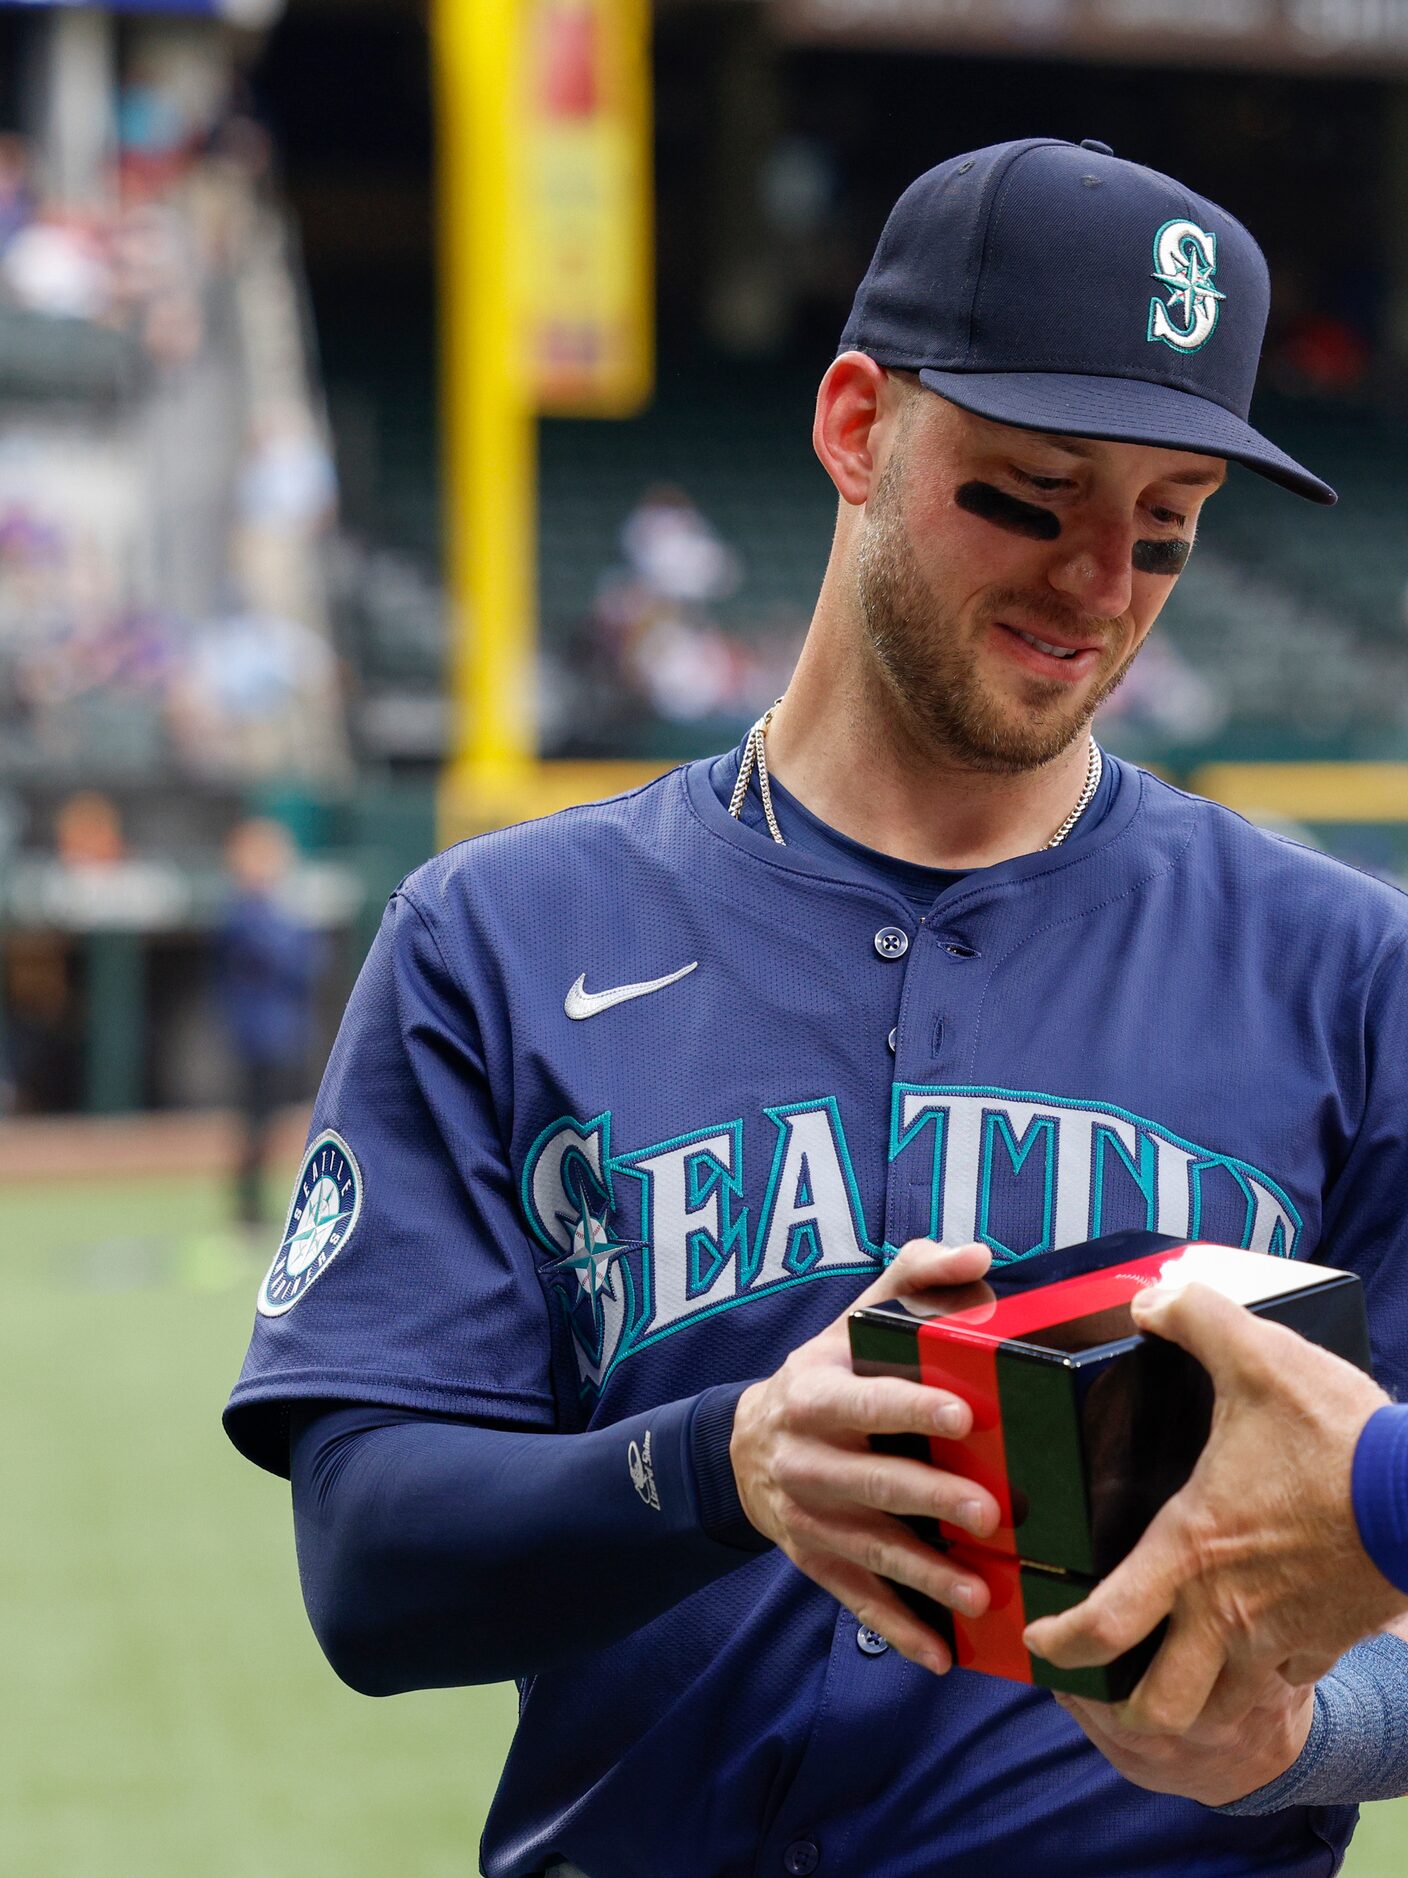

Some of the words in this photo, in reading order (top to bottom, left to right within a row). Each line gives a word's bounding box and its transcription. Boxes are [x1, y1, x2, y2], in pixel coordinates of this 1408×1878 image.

[1147, 219, 1227, 354] S
[294, 1150, 351, 1221] SEATTLE
[271, 1233, 341, 1300] MARINERS
